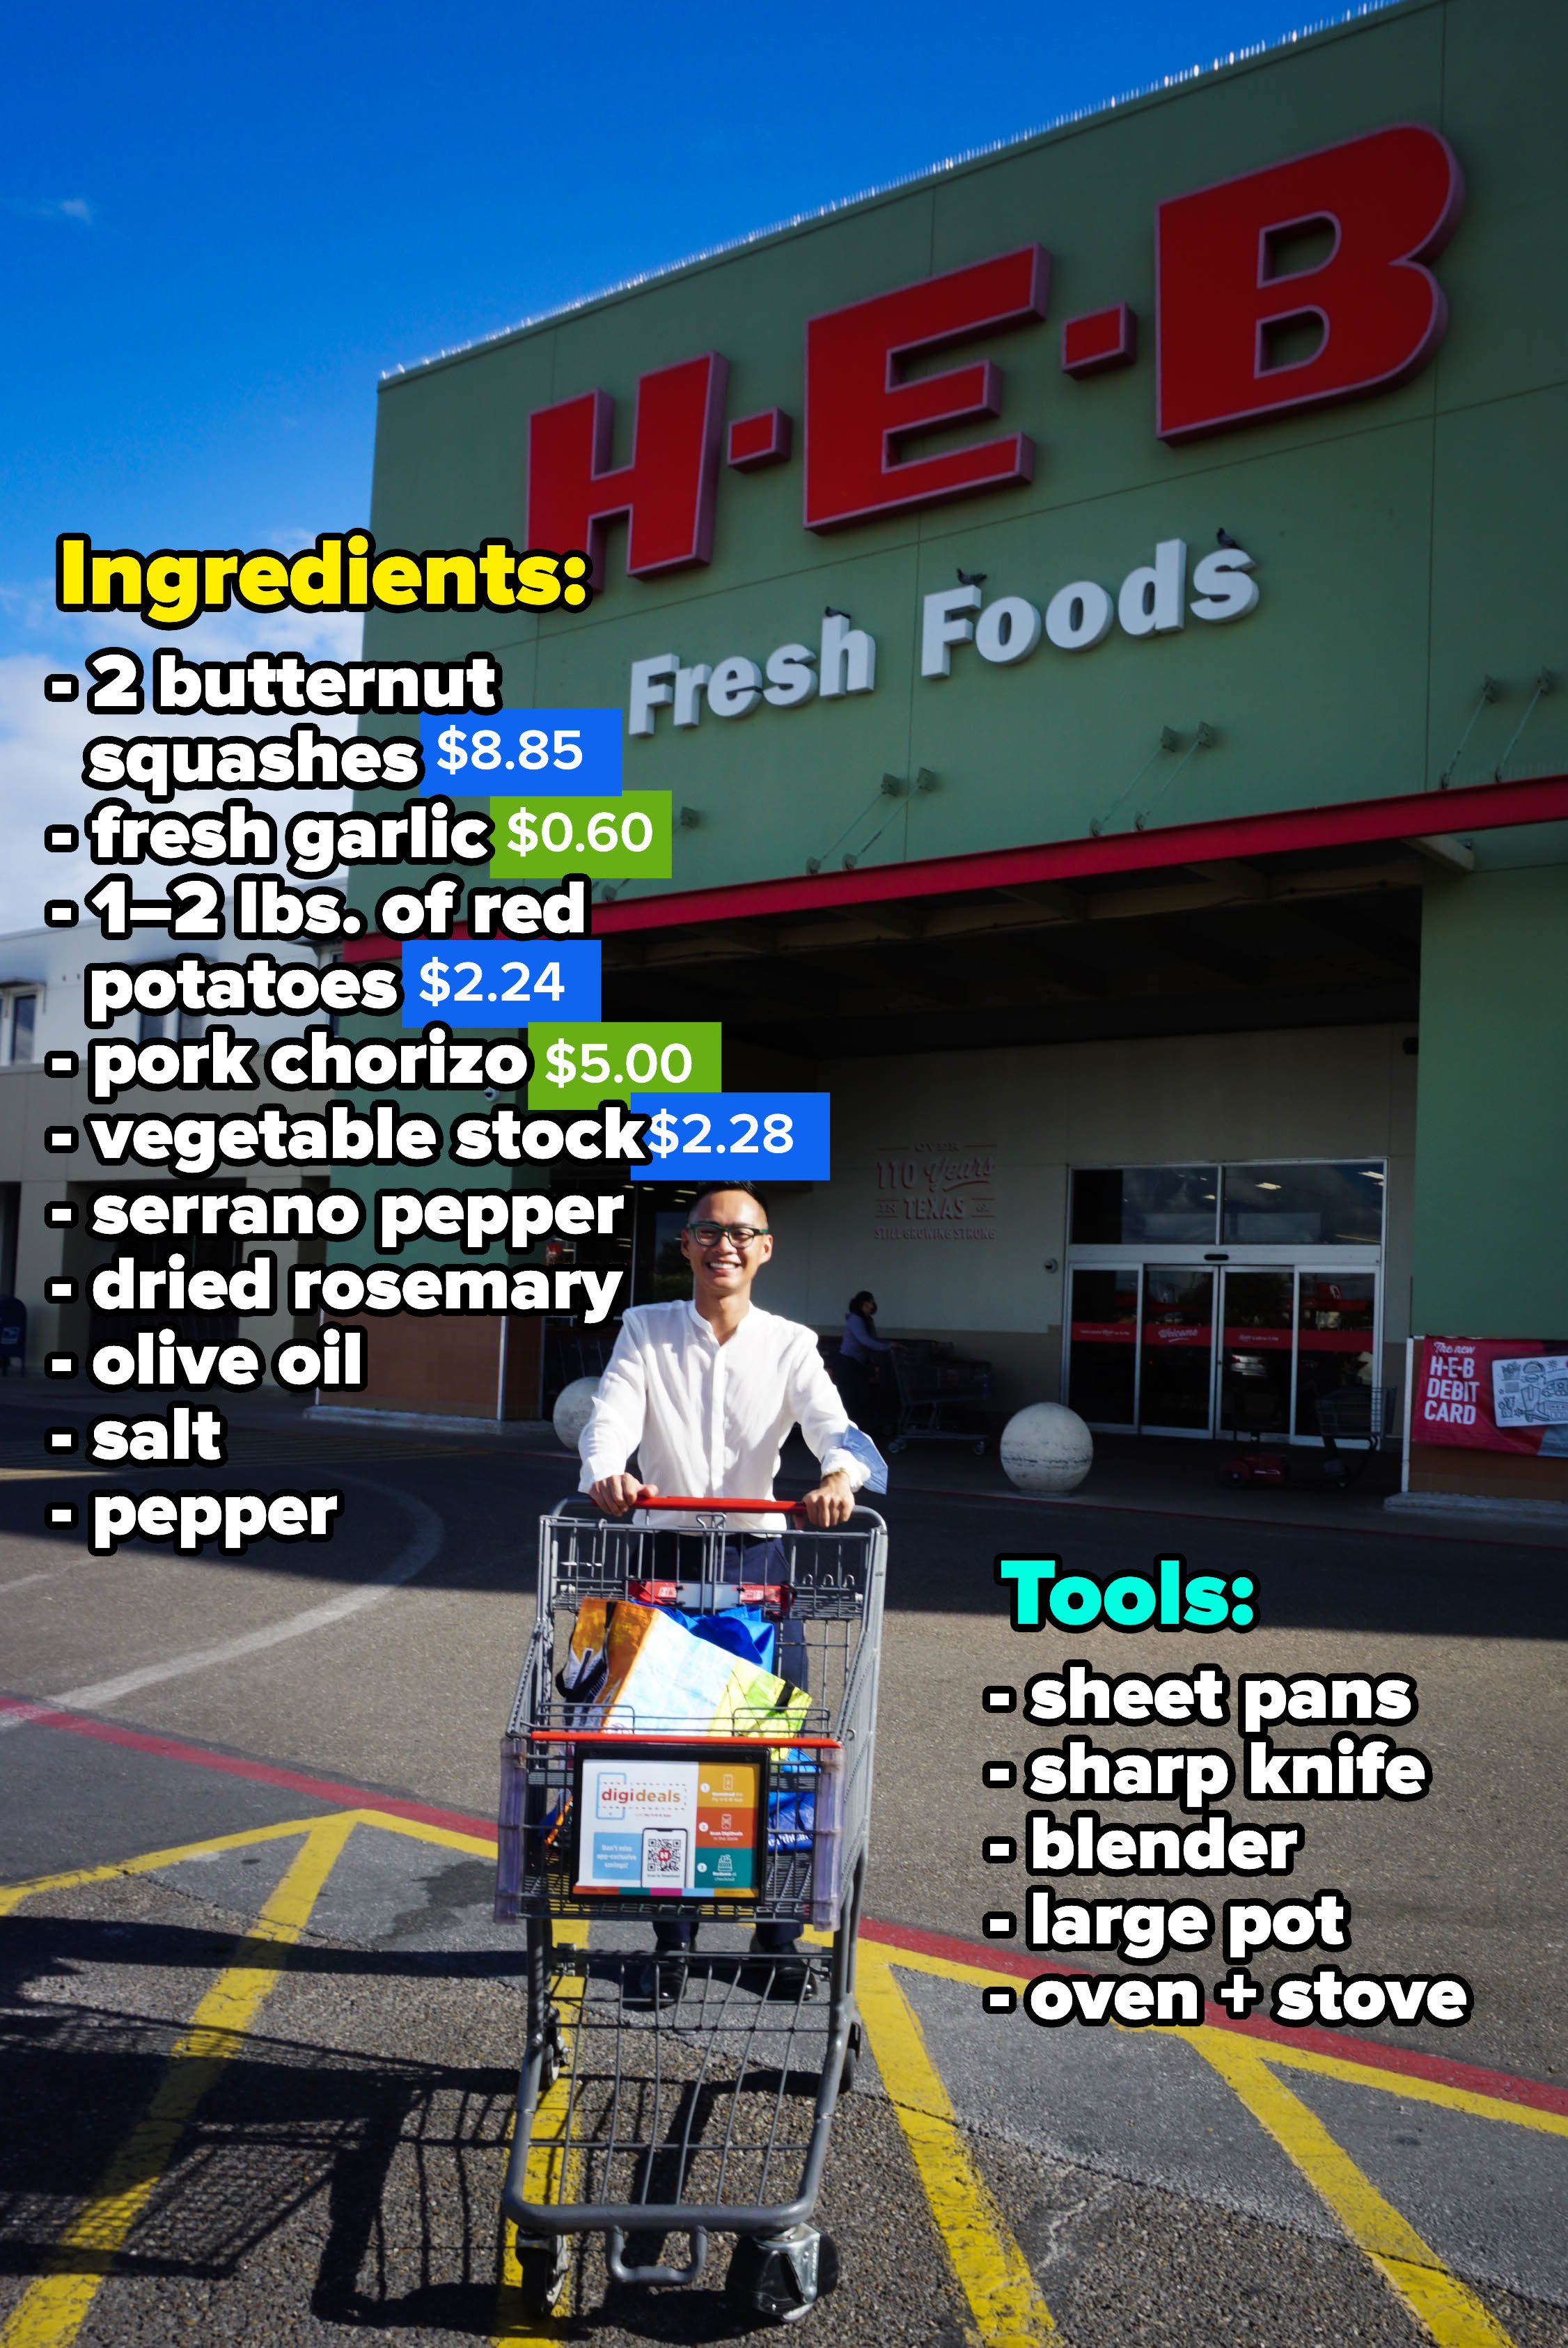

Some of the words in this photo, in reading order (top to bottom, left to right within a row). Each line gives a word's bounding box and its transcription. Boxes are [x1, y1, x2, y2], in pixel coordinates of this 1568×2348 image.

[627, 614, 877, 739] Fresh
[920, 539, 1260, 680] Foods
[876, 1159, 918, 1189] 110
[923, 1156, 993, 1192] Years
[903, 1197, 964, 1220] TEXAS
[874, 1226, 902, 1240] STILL
[904, 1226, 952, 1240] GROWING
[953, 1226, 996, 1240] STRONG
[1434, 1341, 1452, 1354] The
[1454, 1345, 1476, 1354] new
[1429, 1355, 1475, 1379] H-E-B
[1427, 1377, 1480, 1402] DEBIT
[1424, 1400, 1477, 1425] CARD
[602, 1788, 680, 1803] digideals
